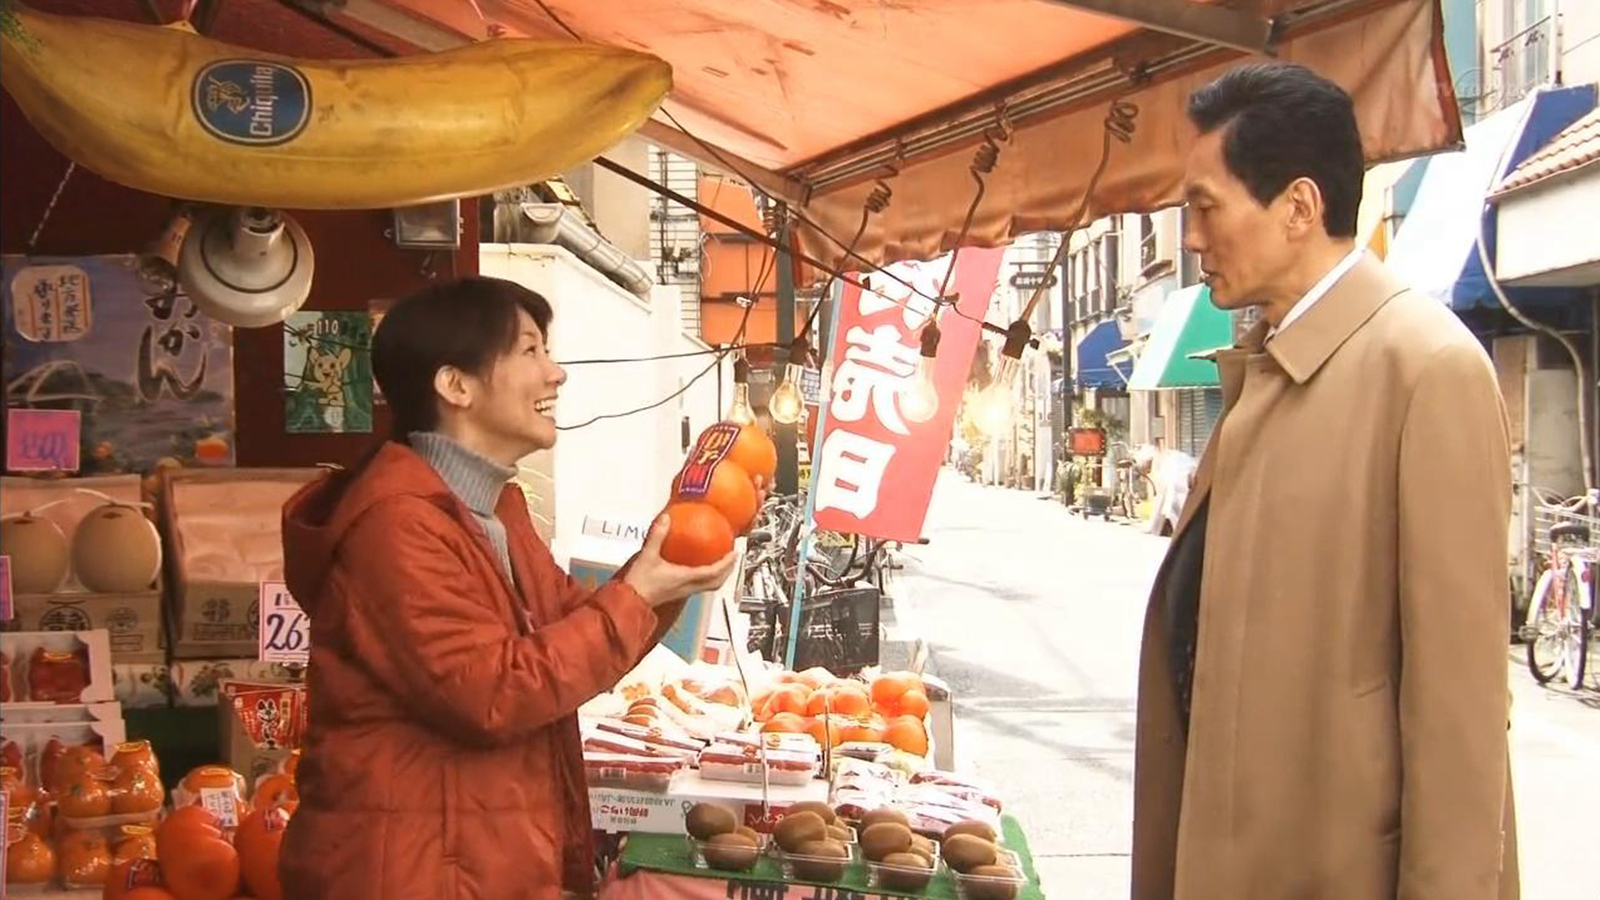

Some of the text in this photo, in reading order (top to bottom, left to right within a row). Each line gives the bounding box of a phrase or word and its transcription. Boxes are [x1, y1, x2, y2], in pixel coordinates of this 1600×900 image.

[249, 65, 279, 136] Chiquita
[602, 520, 646, 540] LIM
[264, 613, 311, 651] 26
